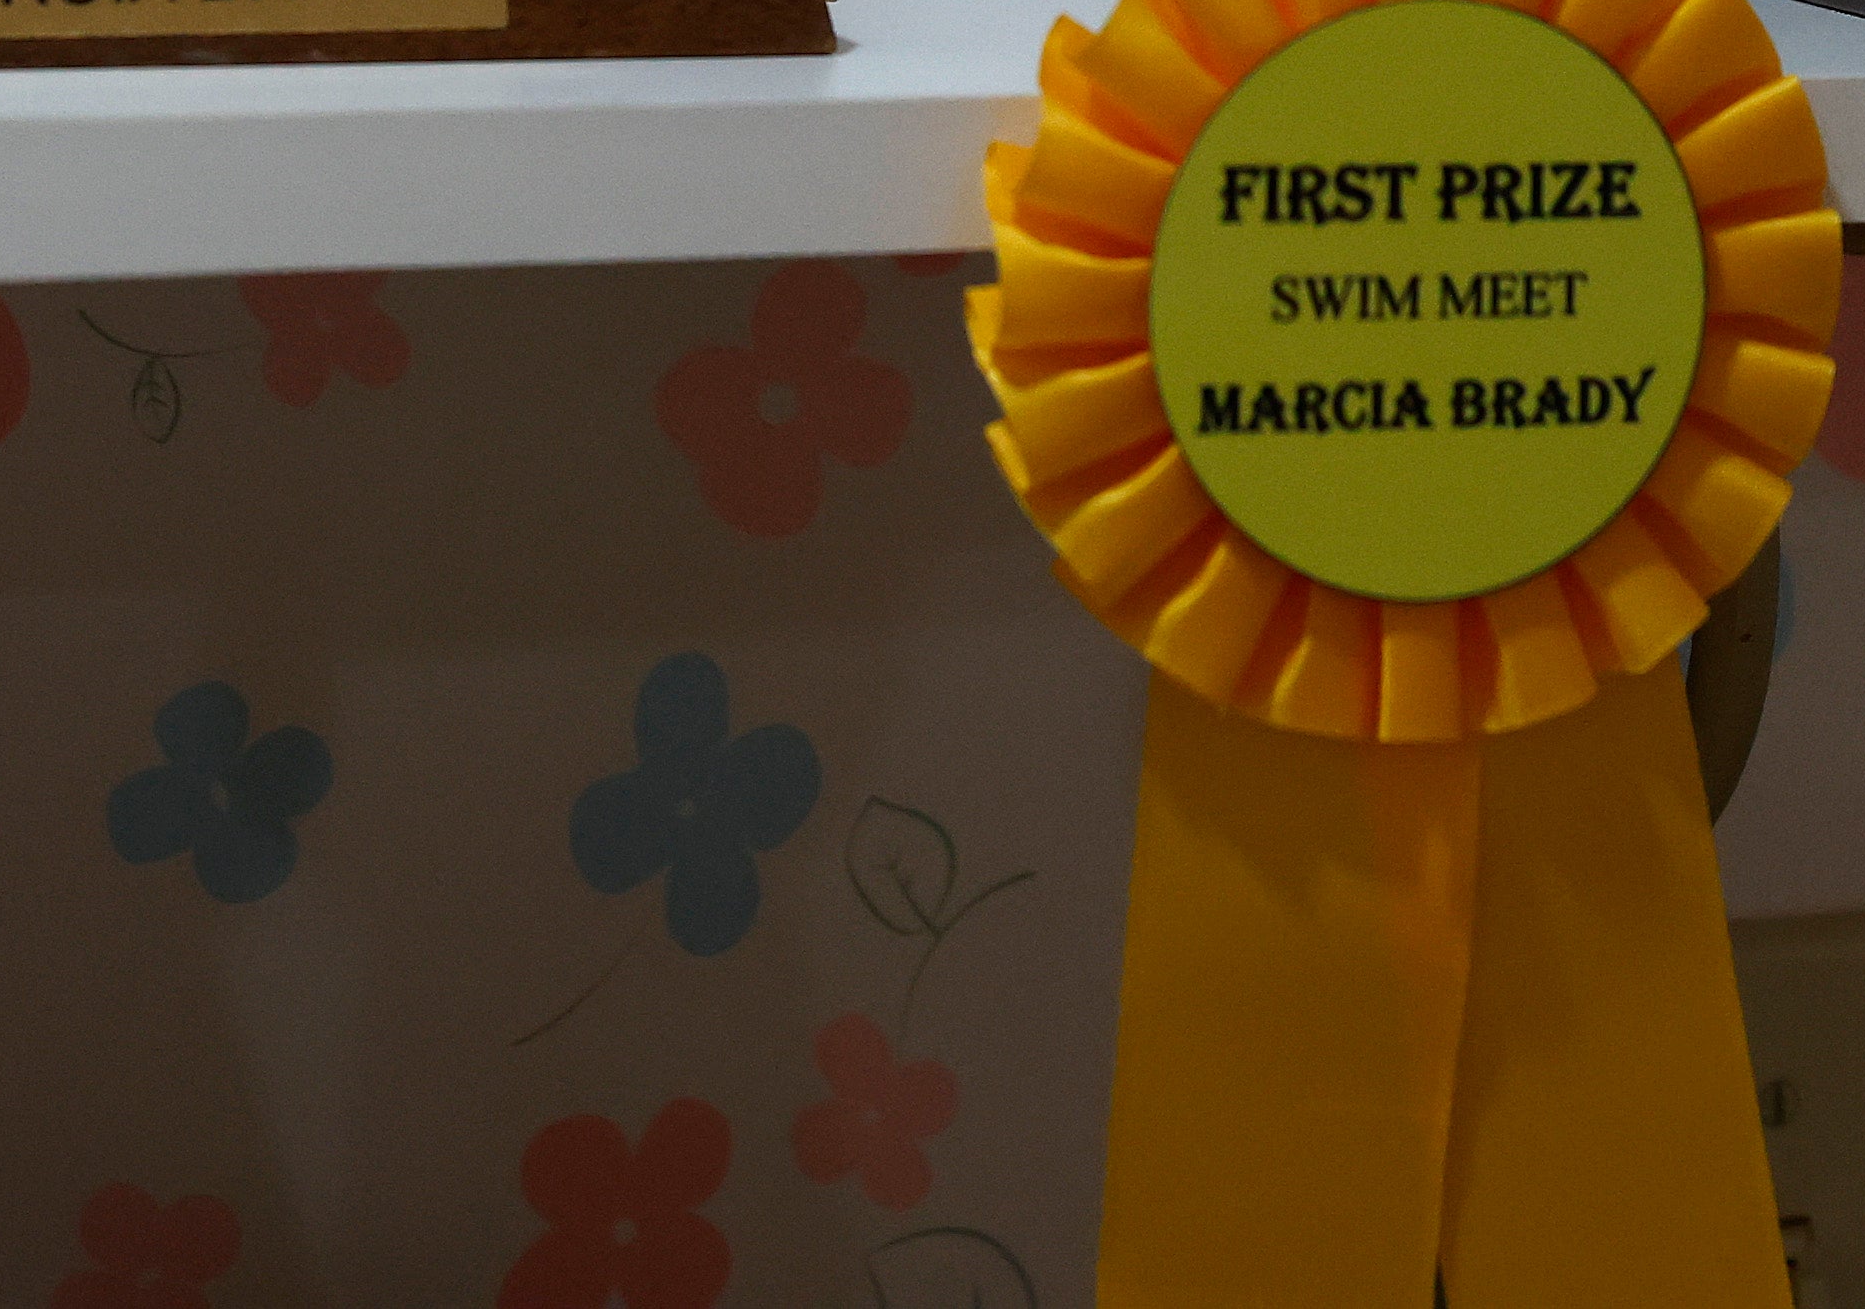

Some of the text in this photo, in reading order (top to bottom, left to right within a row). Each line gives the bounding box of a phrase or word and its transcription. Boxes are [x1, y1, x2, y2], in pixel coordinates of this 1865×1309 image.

[1220, 161, 1642, 225] FIRST PRIZE
[1269, 270, 1588, 322] SWIM MEET
[1196, 366, 1656, 436] MARCIA BRADY
